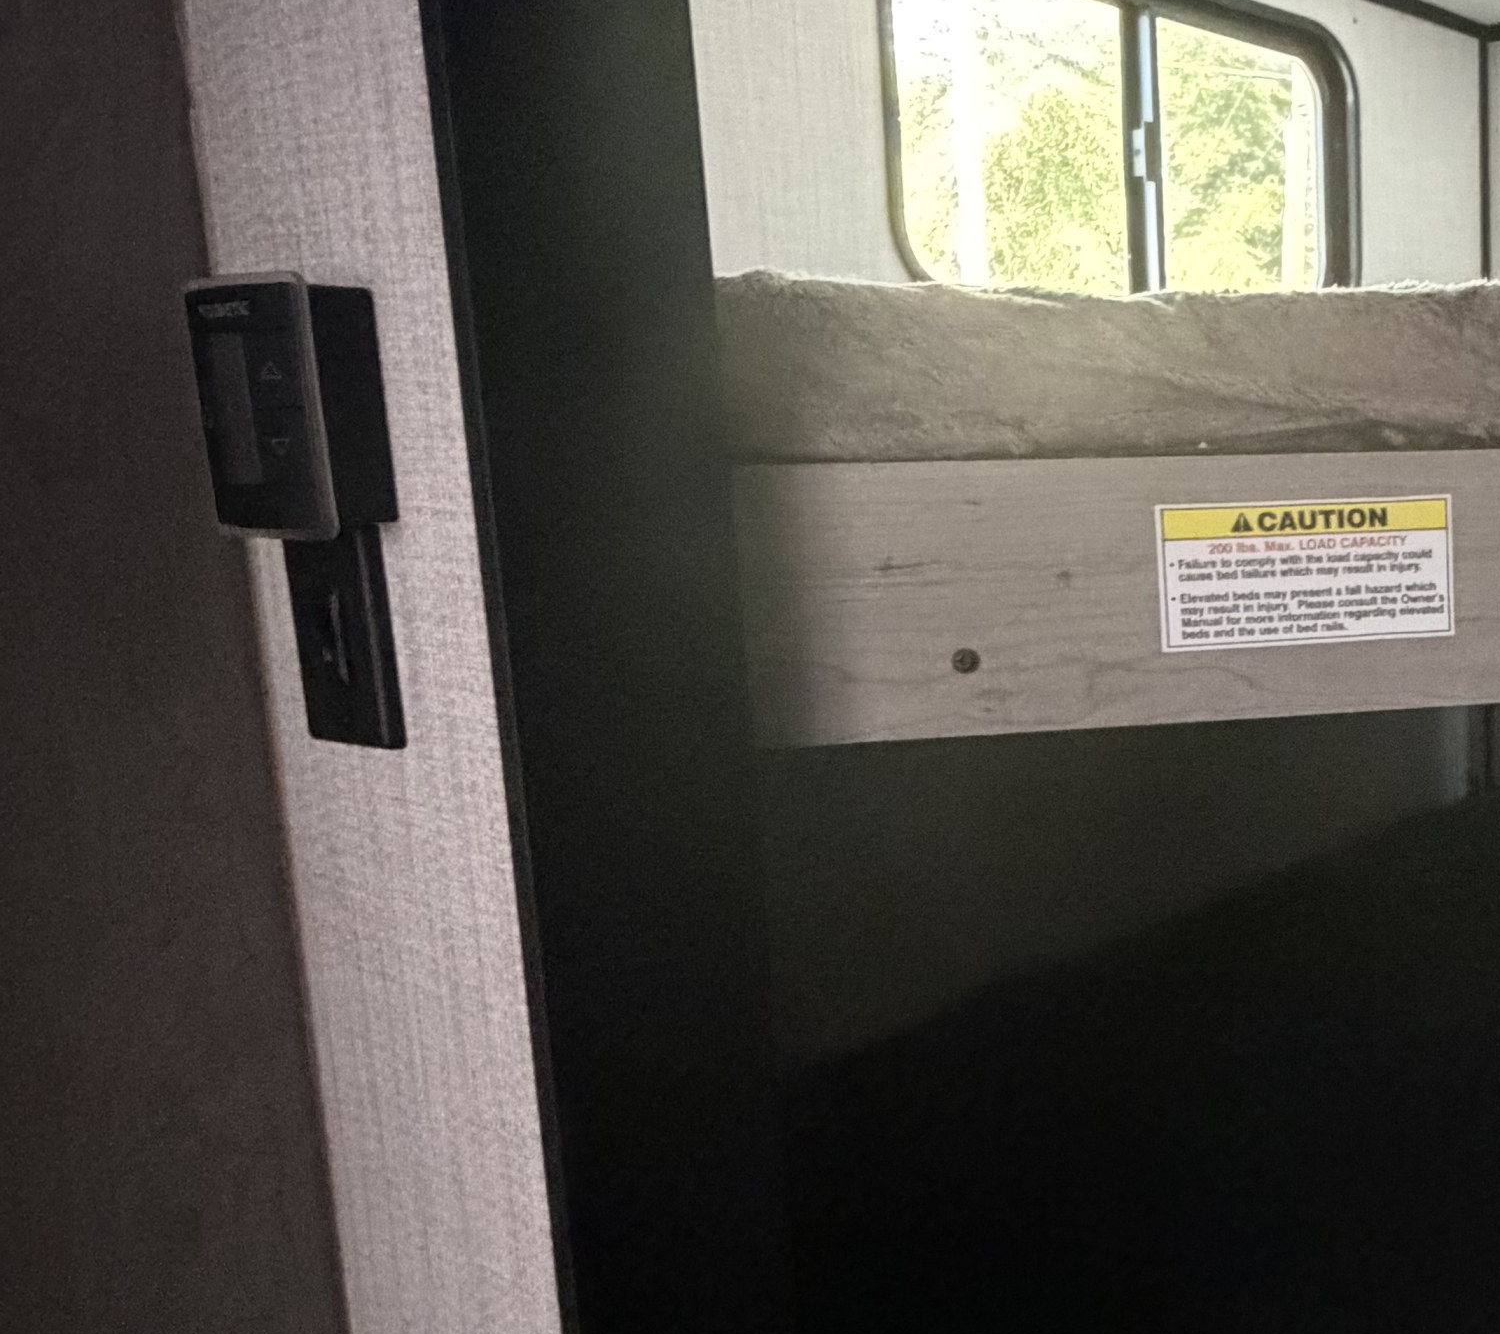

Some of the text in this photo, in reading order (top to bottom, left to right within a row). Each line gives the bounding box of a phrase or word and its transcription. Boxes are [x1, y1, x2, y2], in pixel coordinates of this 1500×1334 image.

[1257, 507, 1388, 532] CAUTION
[1208, 535, 1407, 555] 200 lbs. Max. LOAD CAPACITY
[1178, 549, 1433, 570] Failure to comply with the load capacity could
[1178, 572, 1213, 582] cause
[1216, 569, 1238, 580] bed
[1241, 567, 1276, 579] failure
[1280, 566, 1313, 577] which
[1316, 566, 1339, 578] may
[1342, 563, 1373, 574] result
[1377, 562, 1387, 573] in
[1180, 581, 1437, 604] Elevated beds may present a fall hazard which
[1181, 606, 1204, 617] may
[1208, 603, 1240, 615] result
[1243, 602, 1254, 613] in
[1297, 600, 1335, 610] Please
[1338, 596, 1377, 608] consult
[1381, 595, 1398, 605] the
[1401, 593, 1444, 605] Owner's
[1182, 603, 1444, 628] Manual for more information regarding elevated
[1182, 629, 1210, 640] beds
[1214, 627, 1235, 638] and
[1238, 626, 1256, 637] the
[1259, 626, 1280, 636] use
[1283, 624, 1293, 634] of
[1296, 622, 1318, 634] bed
